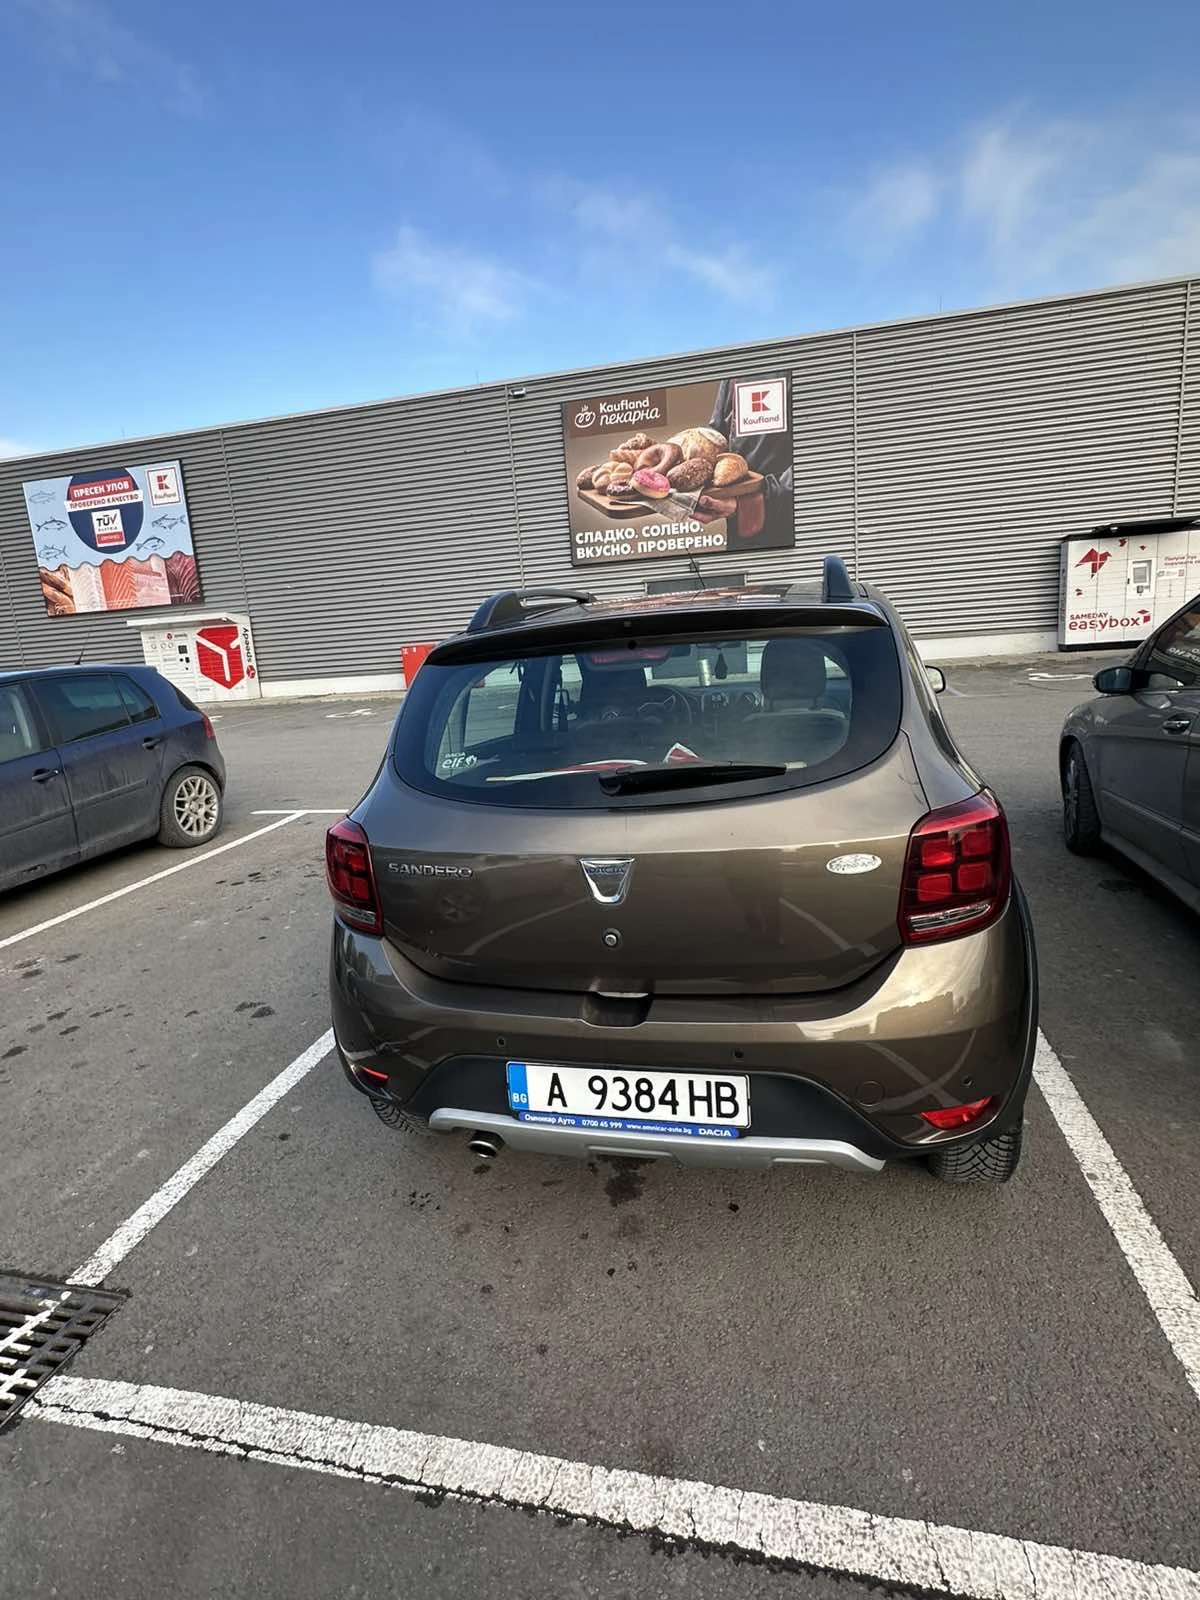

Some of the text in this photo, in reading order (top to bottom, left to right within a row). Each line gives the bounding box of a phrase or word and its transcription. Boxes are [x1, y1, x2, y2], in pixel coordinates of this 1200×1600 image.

[600, 396, 650, 413] Kaufland
[600, 407, 661, 426] пекарна
[743, 414, 780, 425] Kaufland
[73, 480, 130, 498] ПРЕСЕН УЛОВ
[70, 493, 139, 510] ПРОВЕРЕНО КАЧЕСТВО
[575, 520, 704, 545] СЛАДКО. СОЛЕНО.
[576, 534, 728, 560] ВКУСНО. ПРОВЕРЕНО.
[1068, 616, 1140, 631] easybox
[1070, 612, 1109, 620] SAMEDAY
[242, 627, 253, 663] speedy
[388, 862, 473, 878] SANDERO
[588, 866, 625, 875] DACIA
[512, 1093, 527, 1103] BG
[547, 1072, 740, 1119] A 9384 HB
[581, 1119, 599, 1127] 0700
[600, 1120, 609, 1128] 45
[609, 1121, 623, 1129] 999
[698, 1128, 732, 1137] DACIA
